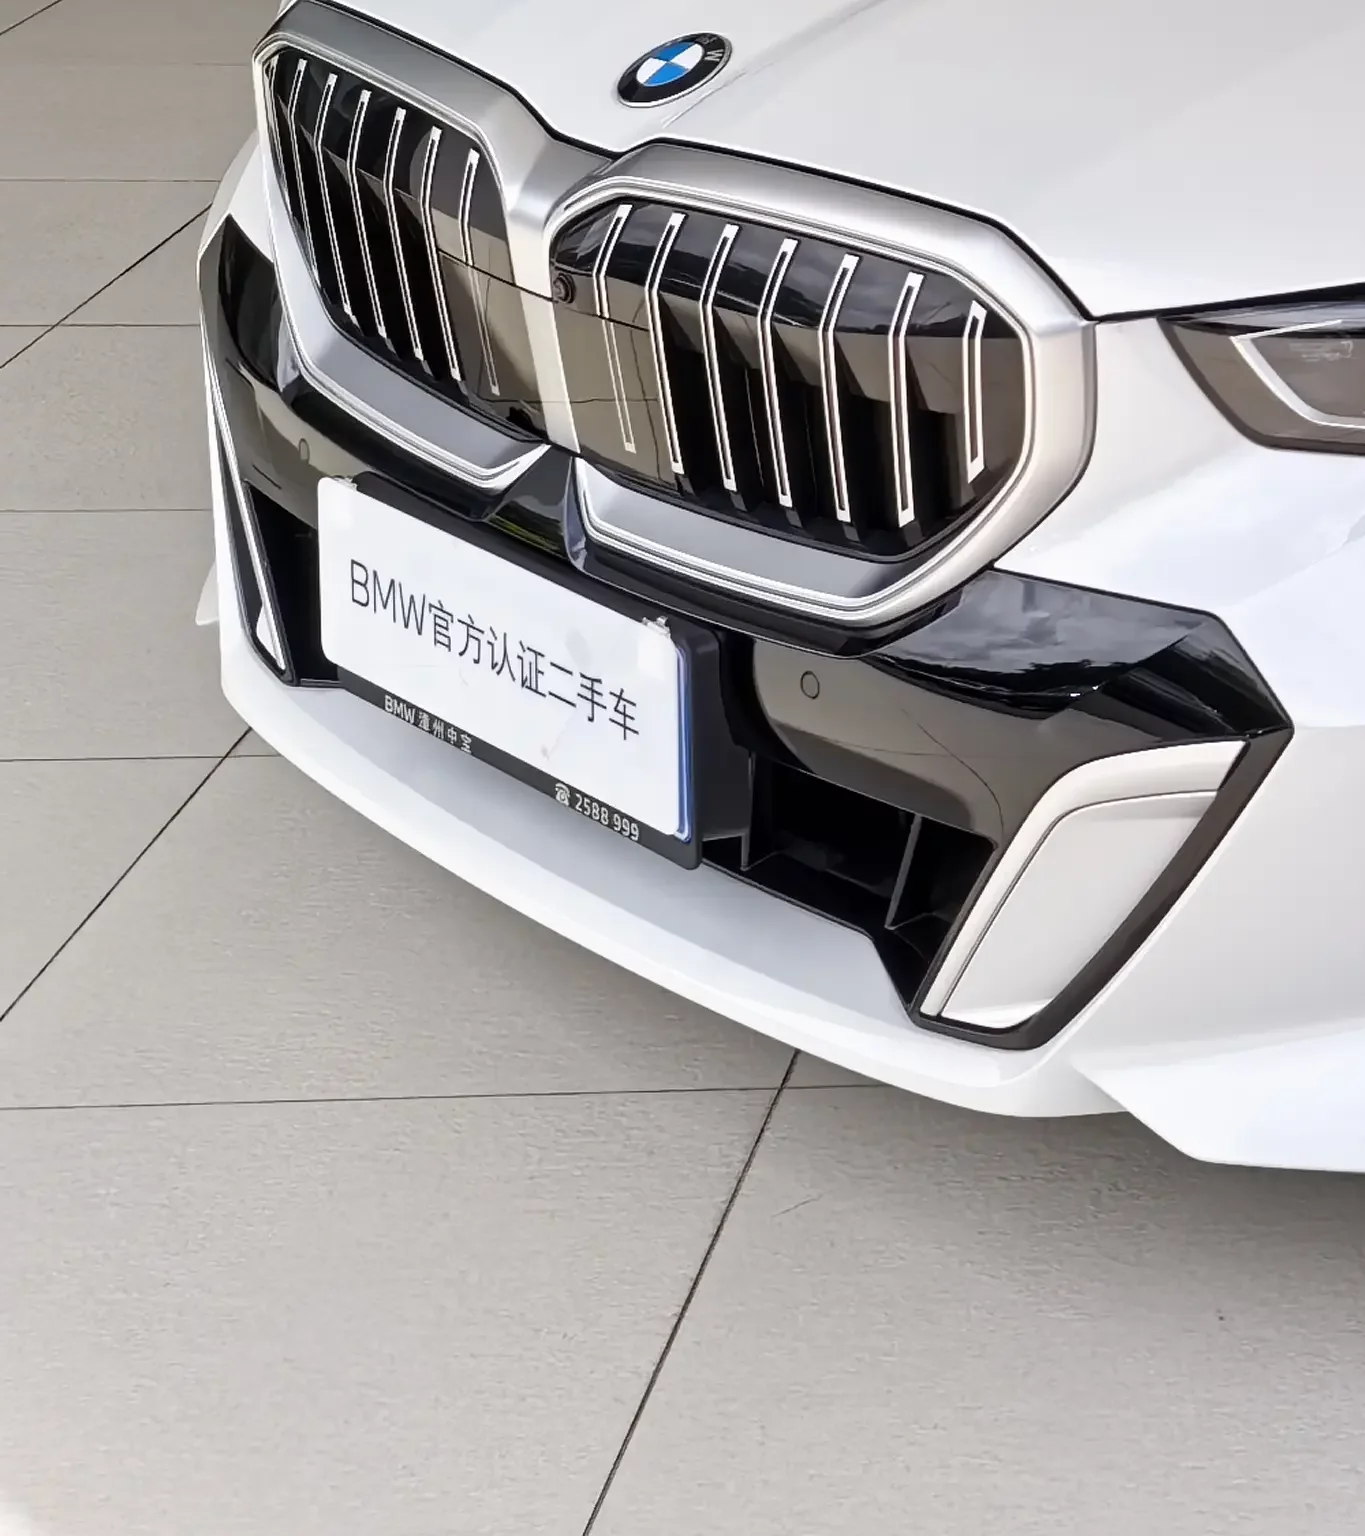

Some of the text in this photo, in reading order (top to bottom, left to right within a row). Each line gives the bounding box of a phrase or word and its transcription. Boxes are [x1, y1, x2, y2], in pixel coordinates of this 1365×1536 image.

[349, 558, 640, 741] BMW官方认证二手车
[384, 694, 417, 726] BMW
